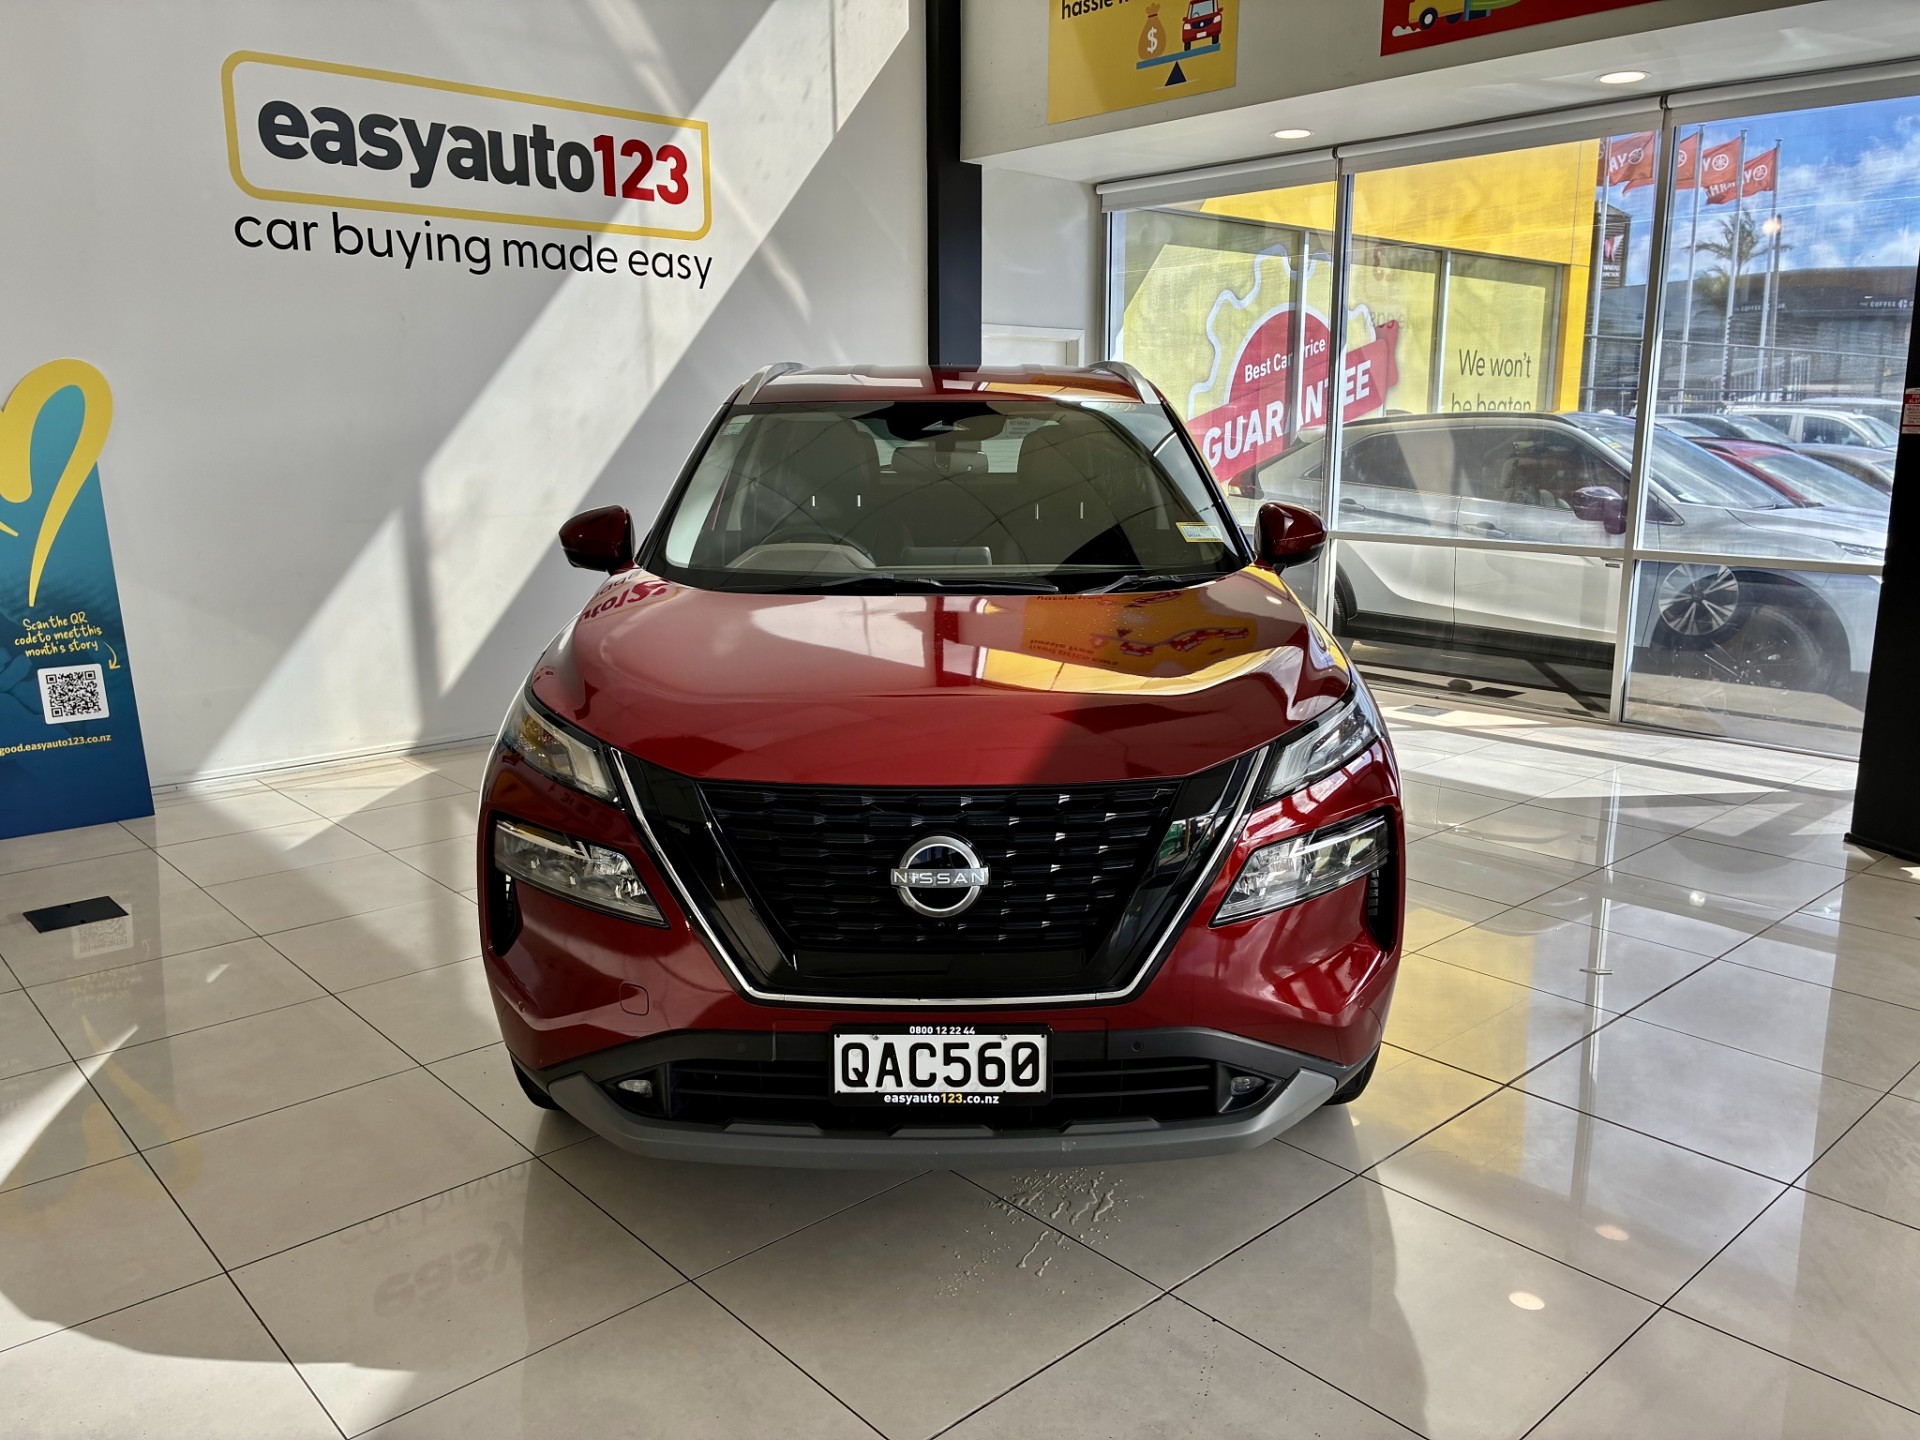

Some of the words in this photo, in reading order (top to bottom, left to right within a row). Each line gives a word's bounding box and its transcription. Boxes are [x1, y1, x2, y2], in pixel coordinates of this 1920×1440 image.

[257, 99, 690, 205] easyauto123
[234, 214, 319, 252] car
[331, 211, 492, 276] buying
[502, 235, 619, 275] made
[627, 249, 713, 290] easy
[1244, 357, 1271, 383] Best
[1273, 351, 1293, 370] Car
[1304, 338, 1326, 359] rice
[1459, 349, 1486, 377] We
[1490, 352, 1531, 378] won't
[1202, 359, 1372, 469] GUARNEE
[22, 618, 50, 631] Scan
[48, 615, 68, 628] the
[70, 611, 88, 625] QR
[14, 632, 38, 646] code
[36, 631, 52, 643] to
[54, 626, 81, 641] meet
[80, 624, 103, 637] this
[24, 641, 66, 658] month's
[68, 638, 99, 652] story
[893, 870, 986, 884] NISSAN
[909, 1025, 934, 1036] 0800
[936, 1025, 948, 1036] 12
[949, 1025, 962, 1036] 22
[963, 1026, 976, 1036] 44
[841, 1041, 1040, 1089] QAC560
[883, 1093, 1000, 1105] easyauto123.co.nz
